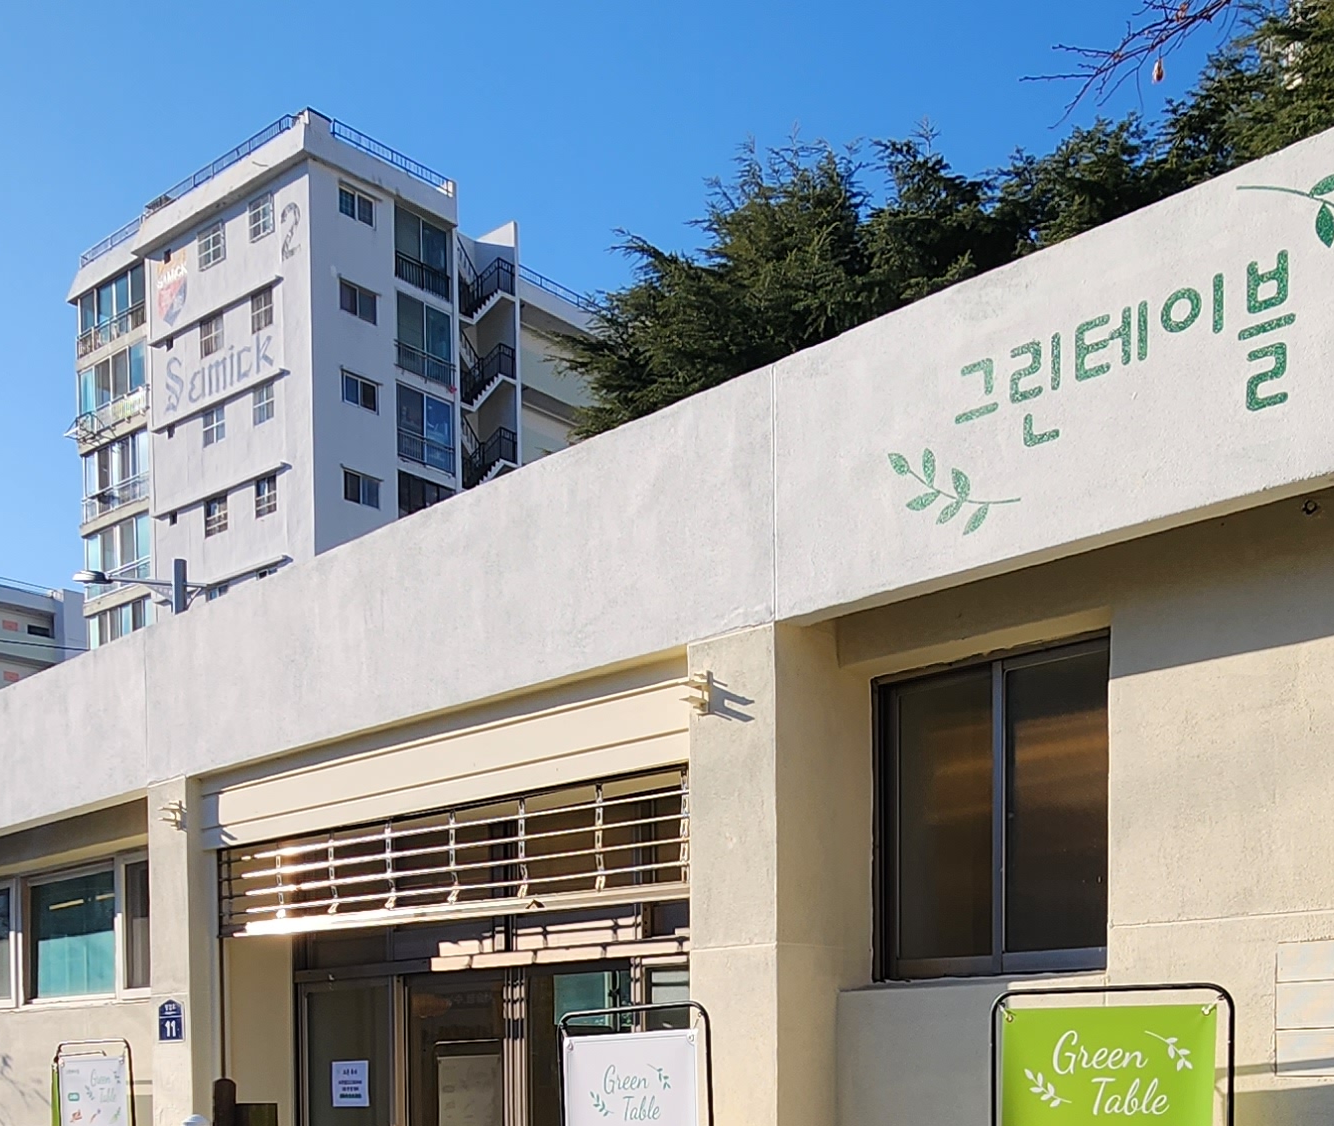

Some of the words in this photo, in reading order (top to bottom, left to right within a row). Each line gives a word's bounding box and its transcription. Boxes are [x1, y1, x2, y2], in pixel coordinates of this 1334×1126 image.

[280, 202, 302, 262] 2
[954, 248, 1299, 448] 그린테이블
[163, 334, 275, 413] Samick
[164, 1020, 177, 1038] 11
[1052, 1030, 1149, 1075] Green
[603, 1064, 649, 1095] Green
[1091, 1077, 1170, 1116] Table
[623, 1095, 661, 1121] Table
